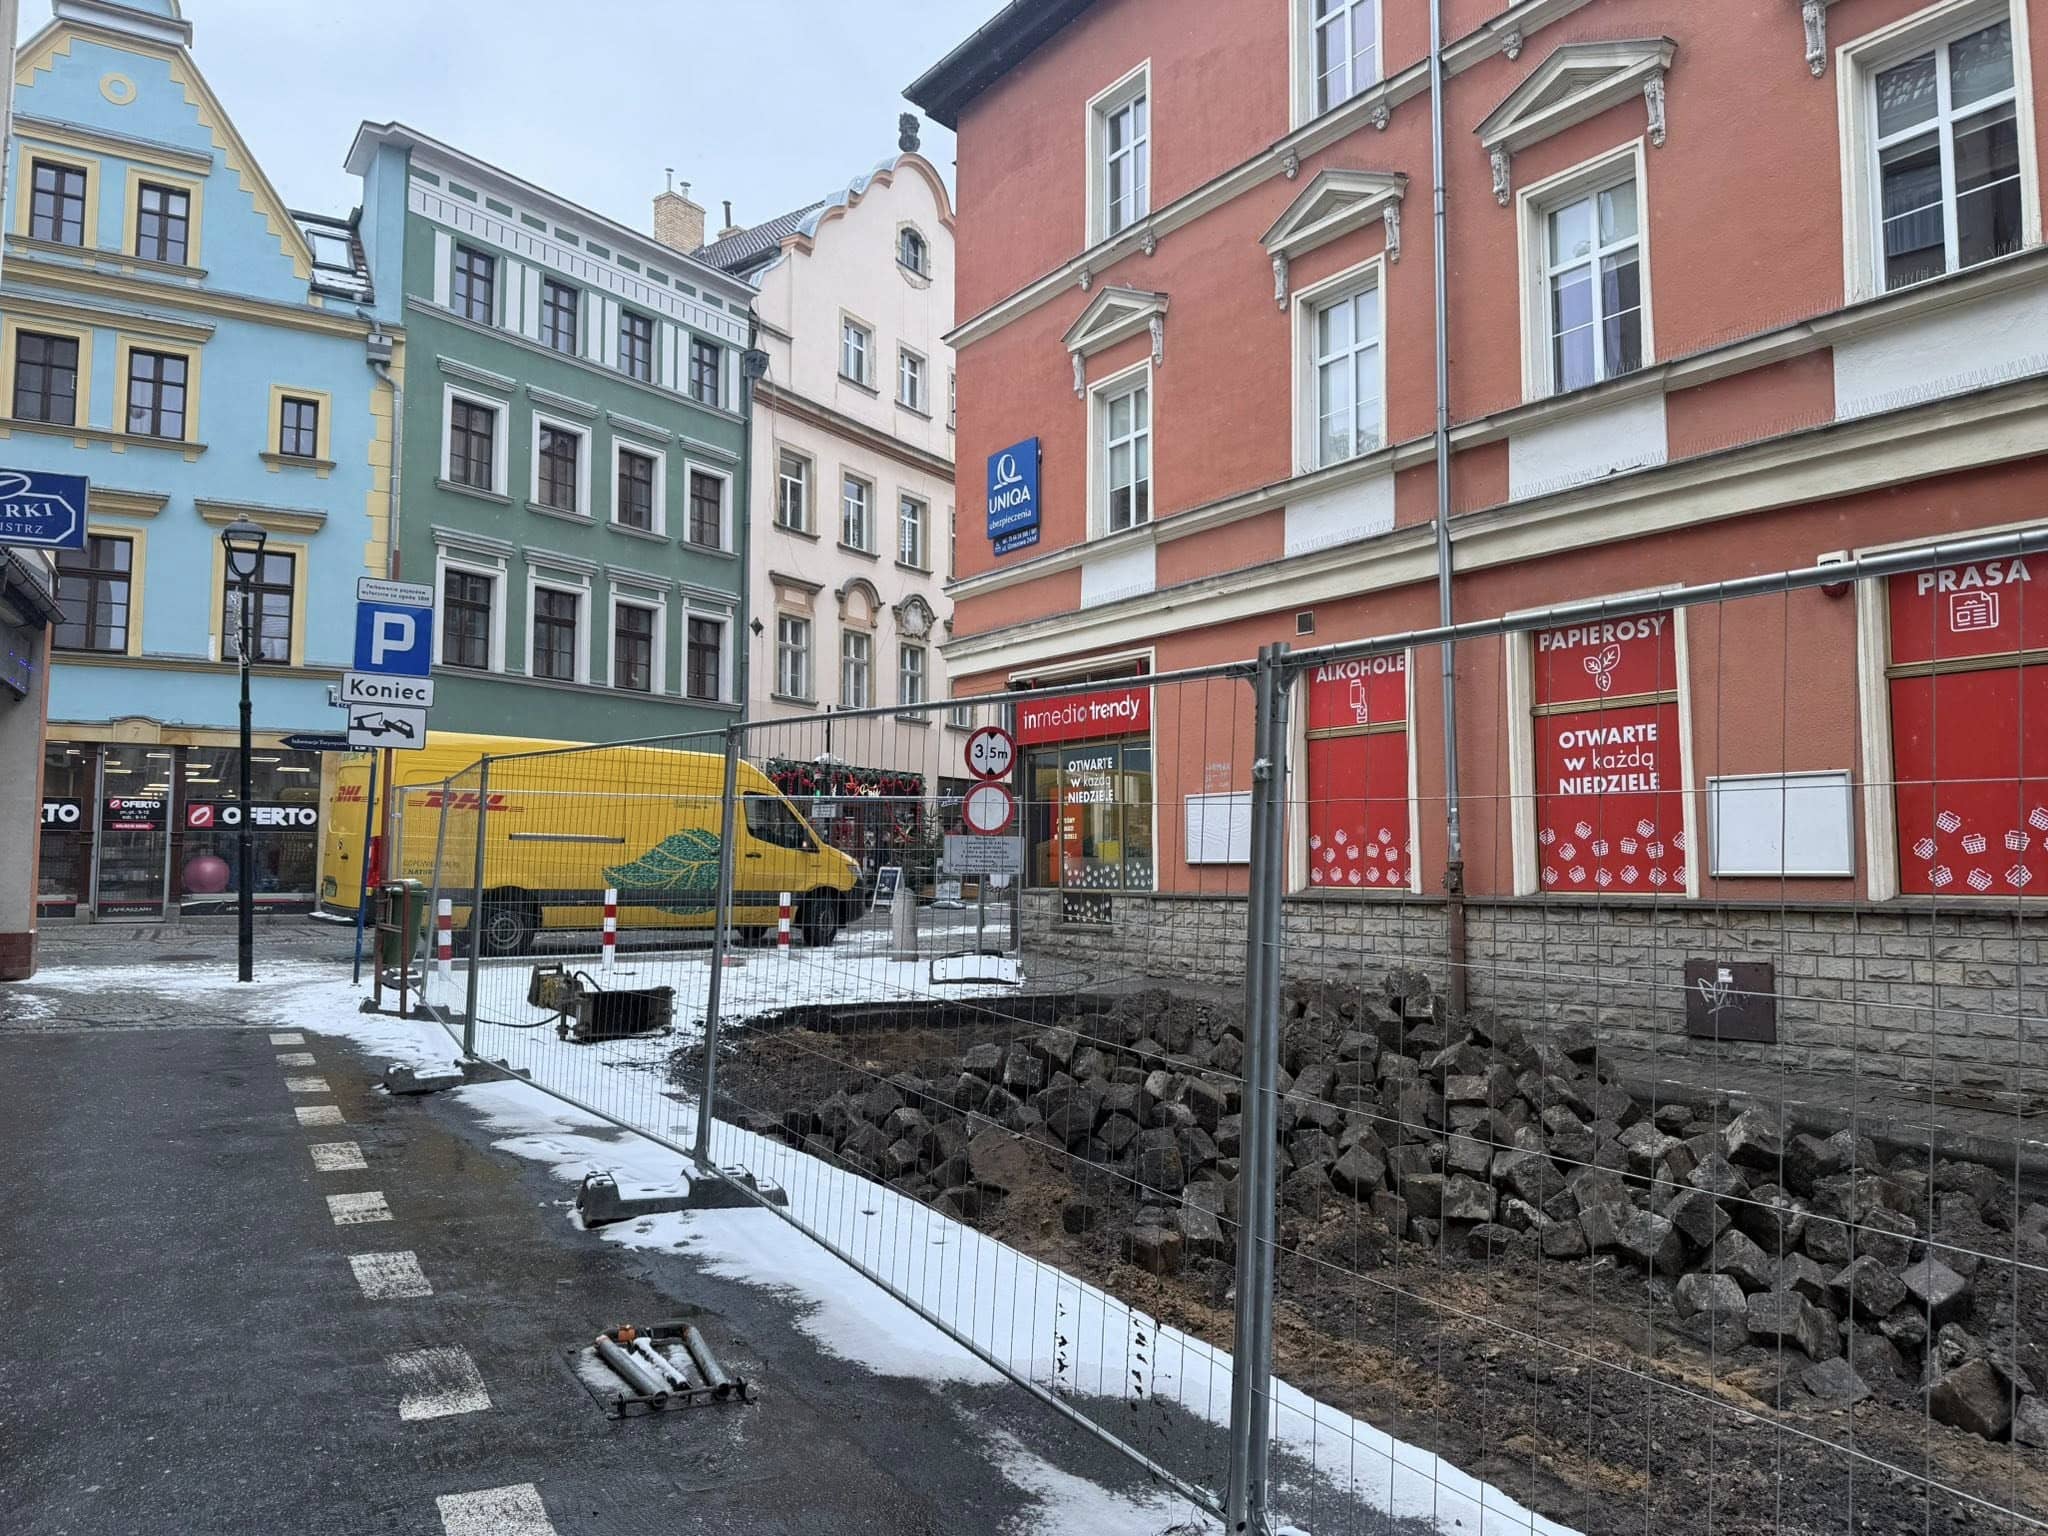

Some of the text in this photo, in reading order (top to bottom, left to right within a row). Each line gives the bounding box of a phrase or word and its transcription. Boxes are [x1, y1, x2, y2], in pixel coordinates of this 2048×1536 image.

[0, 502, 54, 518] RKI
[988, 485, 1031, 514] UNIQA
[1917, 559, 2031, 596] PRASA
[371, 611, 416, 665] P
[1539, 615, 1666, 652] PAPIEROSY
[1316, 654, 1405, 683] ALKOHOLE
[350, 678, 426, 701] Koniec
[1024, 694, 1140, 729] inmedio trendy
[1559, 723, 1657, 749] OTWARTE
[974, 743, 1008, 760] 3,5m
[1564, 745, 1654, 771] w każdą
[1068, 757, 1113, 773] OTWARTE
[1070, 770, 1111, 788] w każdą
[121, 800, 161, 808] OFERTO
[335, 785, 364, 802] DHL
[424, 791, 510, 812] DHL
[41, 803, 80, 823] TO
